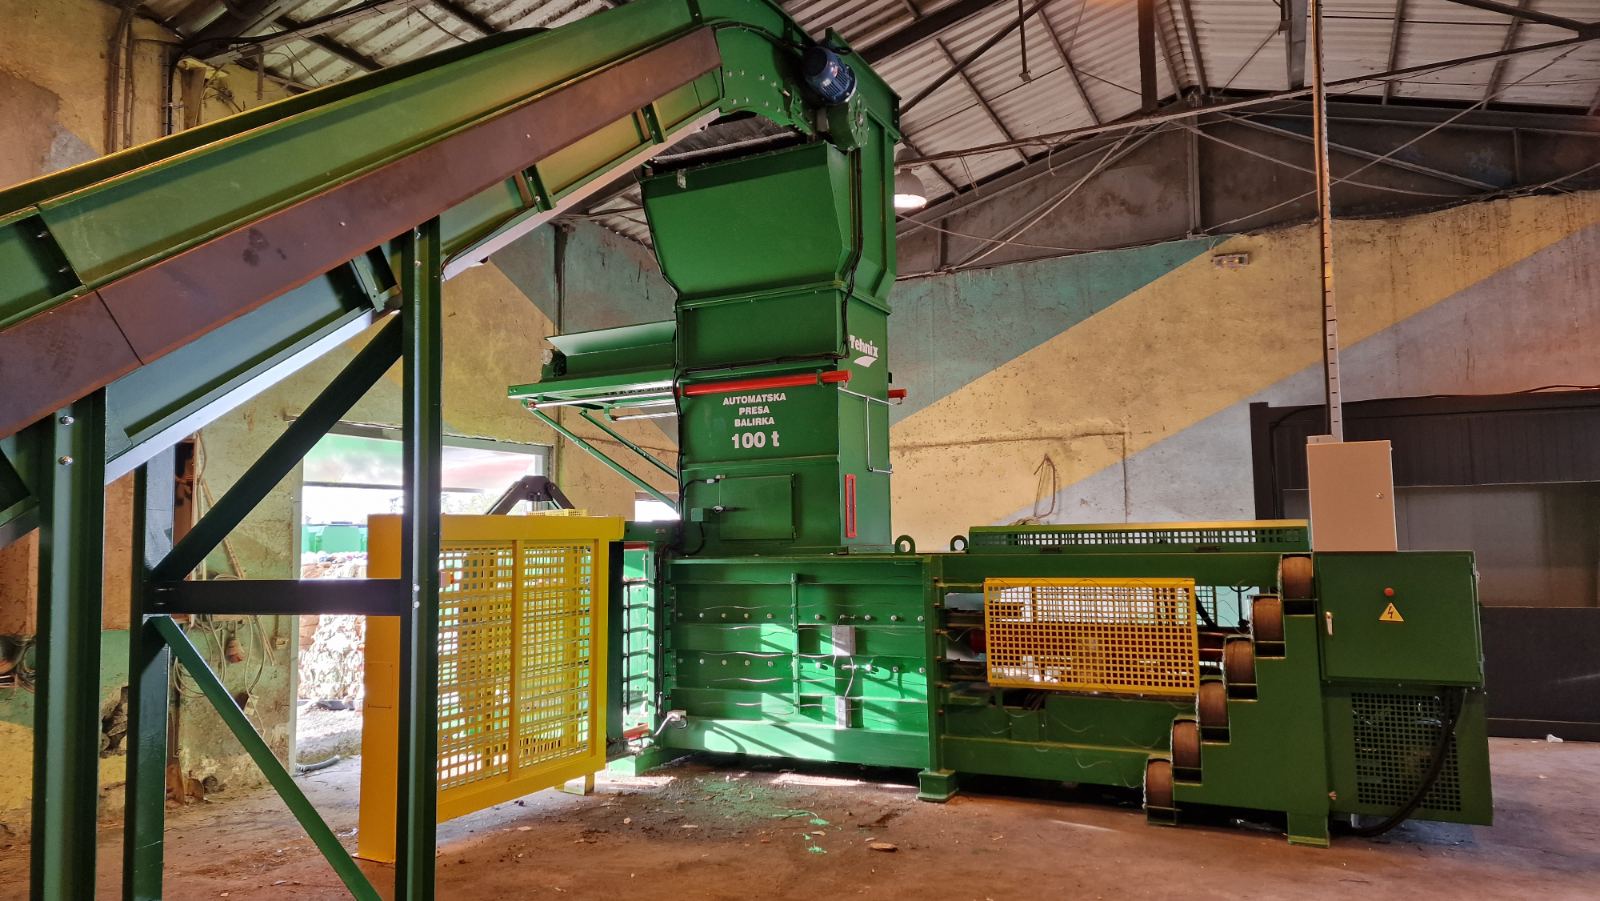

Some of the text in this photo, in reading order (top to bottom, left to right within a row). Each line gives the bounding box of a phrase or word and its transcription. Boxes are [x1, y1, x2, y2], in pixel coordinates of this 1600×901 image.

[848, 334, 878, 357] Tehnix
[722, 393, 786, 405] AUTOMATSKA
[738, 406, 770, 415] PRESA
[734, 417, 775, 427] BALIRKA
[731, 431, 780, 448] 100 t
